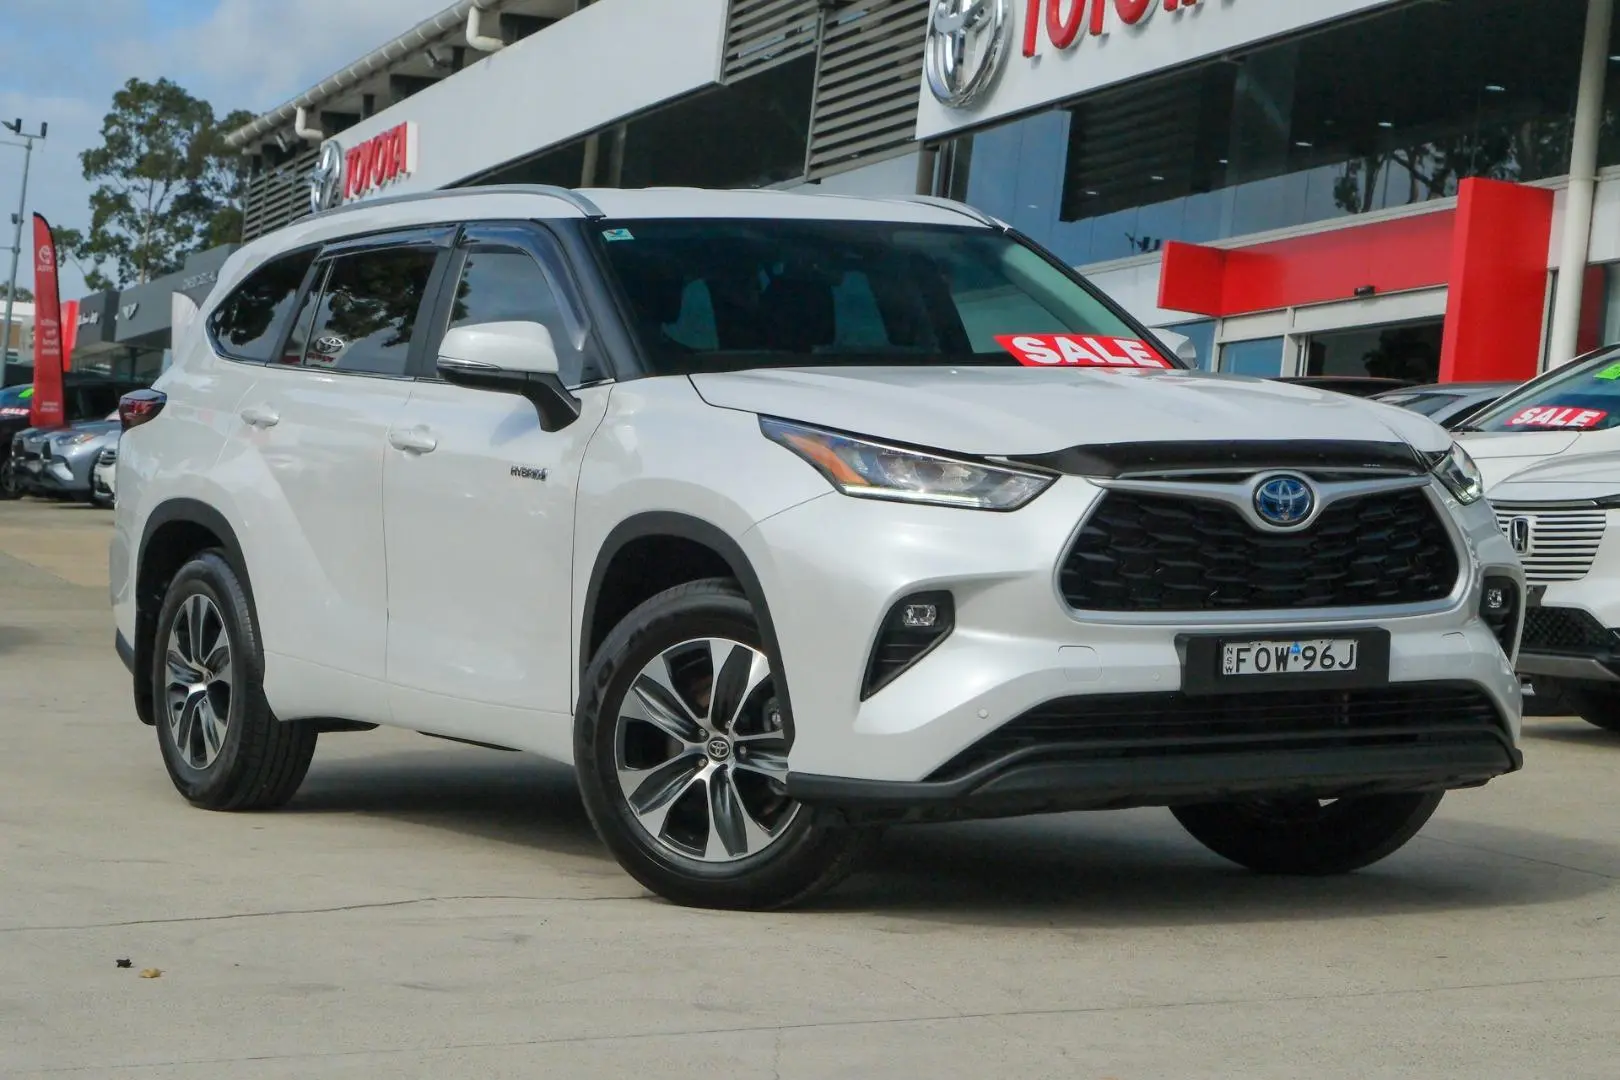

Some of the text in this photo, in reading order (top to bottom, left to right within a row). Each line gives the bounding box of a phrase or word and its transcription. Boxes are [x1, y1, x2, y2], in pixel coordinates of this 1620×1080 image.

[344, 121, 407, 199] TOYOTA
[1012, 336, 1163, 368] SALE
[1512, 407, 1600, 426] SALE
[1225, 647, 1234, 673] NSW
